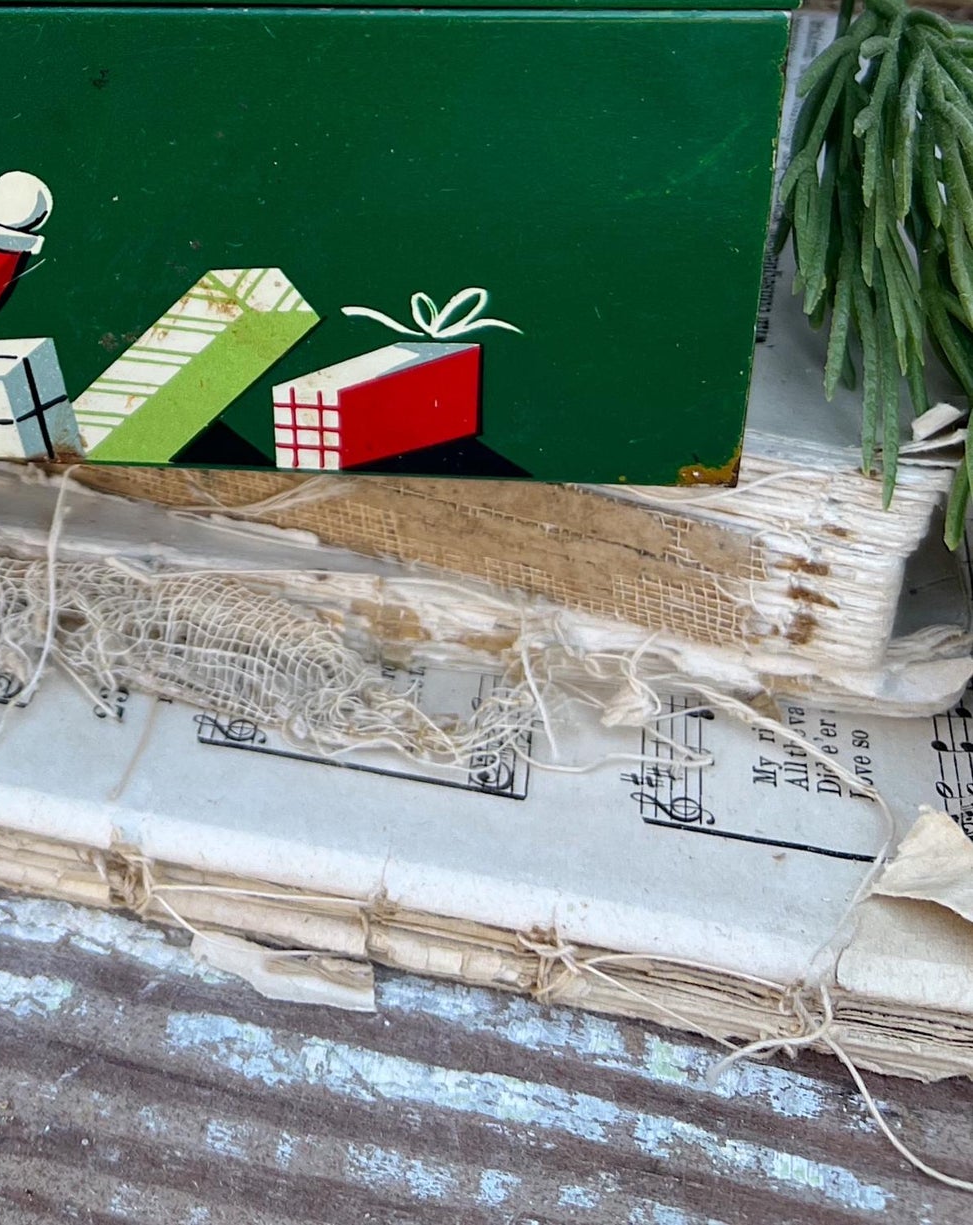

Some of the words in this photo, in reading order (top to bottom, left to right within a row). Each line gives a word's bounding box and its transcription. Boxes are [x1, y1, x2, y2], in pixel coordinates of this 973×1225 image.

[813, 719, 839, 755] e'er
[851, 729, 869, 749] so
[752, 756, 783, 787] My
[783, 761, 809, 791] All
